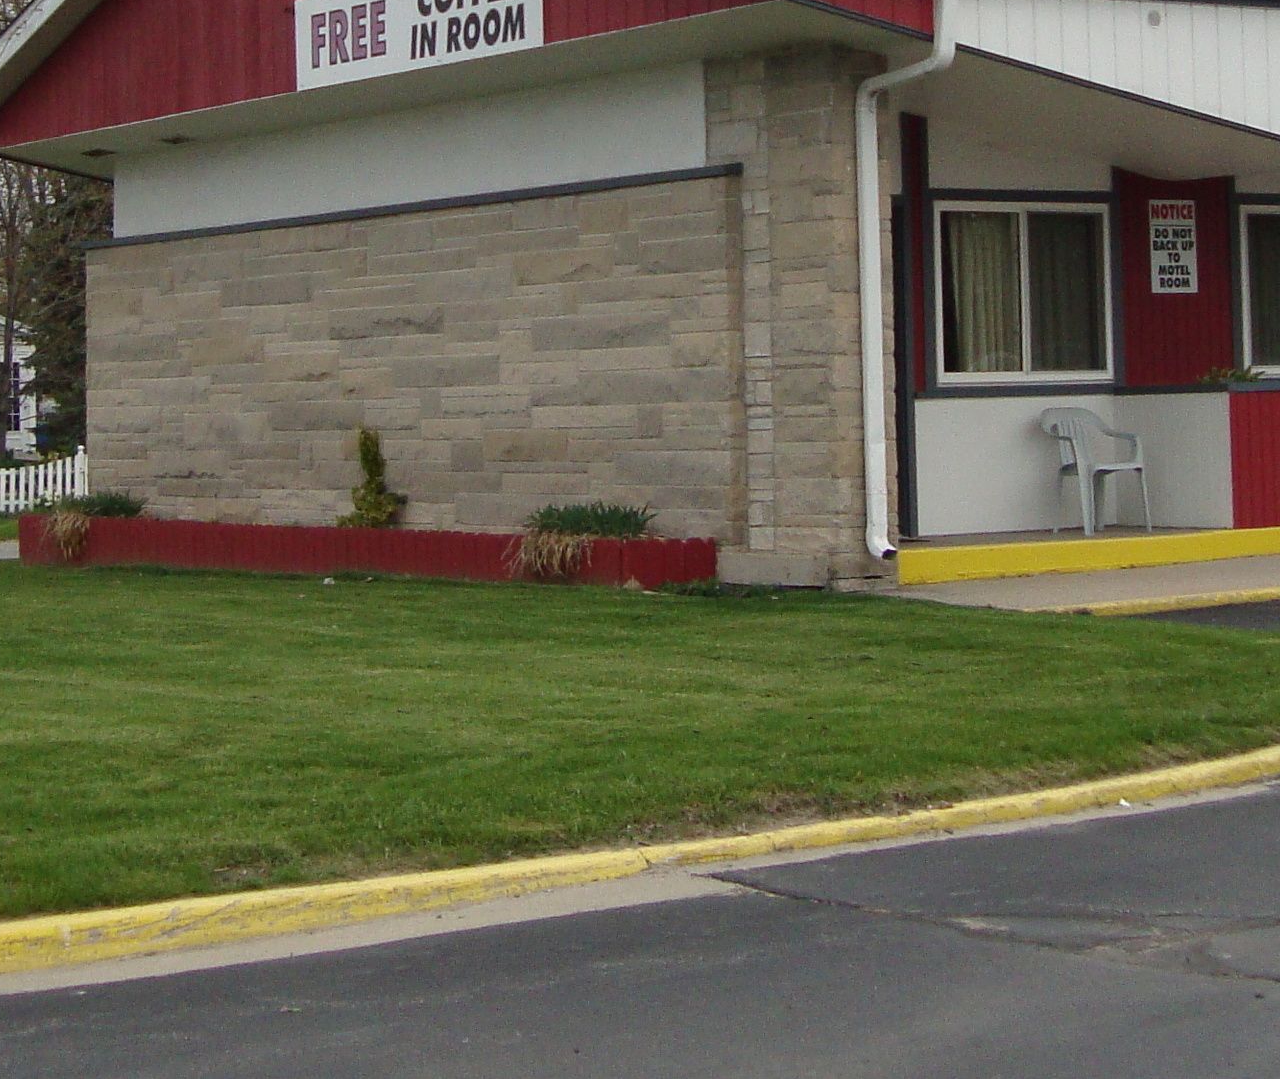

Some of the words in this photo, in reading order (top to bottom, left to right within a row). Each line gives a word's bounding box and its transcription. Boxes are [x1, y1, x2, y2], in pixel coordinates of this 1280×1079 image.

[311, 0, 386, 69] FREE
[410, 21, 437, 60] IN
[447, 3, 525, 53] ROOM
[1151, 204, 1193, 220] NOTICE
[1154, 229, 1168, 238] DO
[1173, 229, 1192, 238] NOT
[1153, 240, 1178, 251] BACK
[1182, 241, 1194, 251] UP
[1168, 253, 1180, 263] TO
[1158, 265, 1190, 275] MOTEL
[1159, 278, 1190, 288] ROOM
